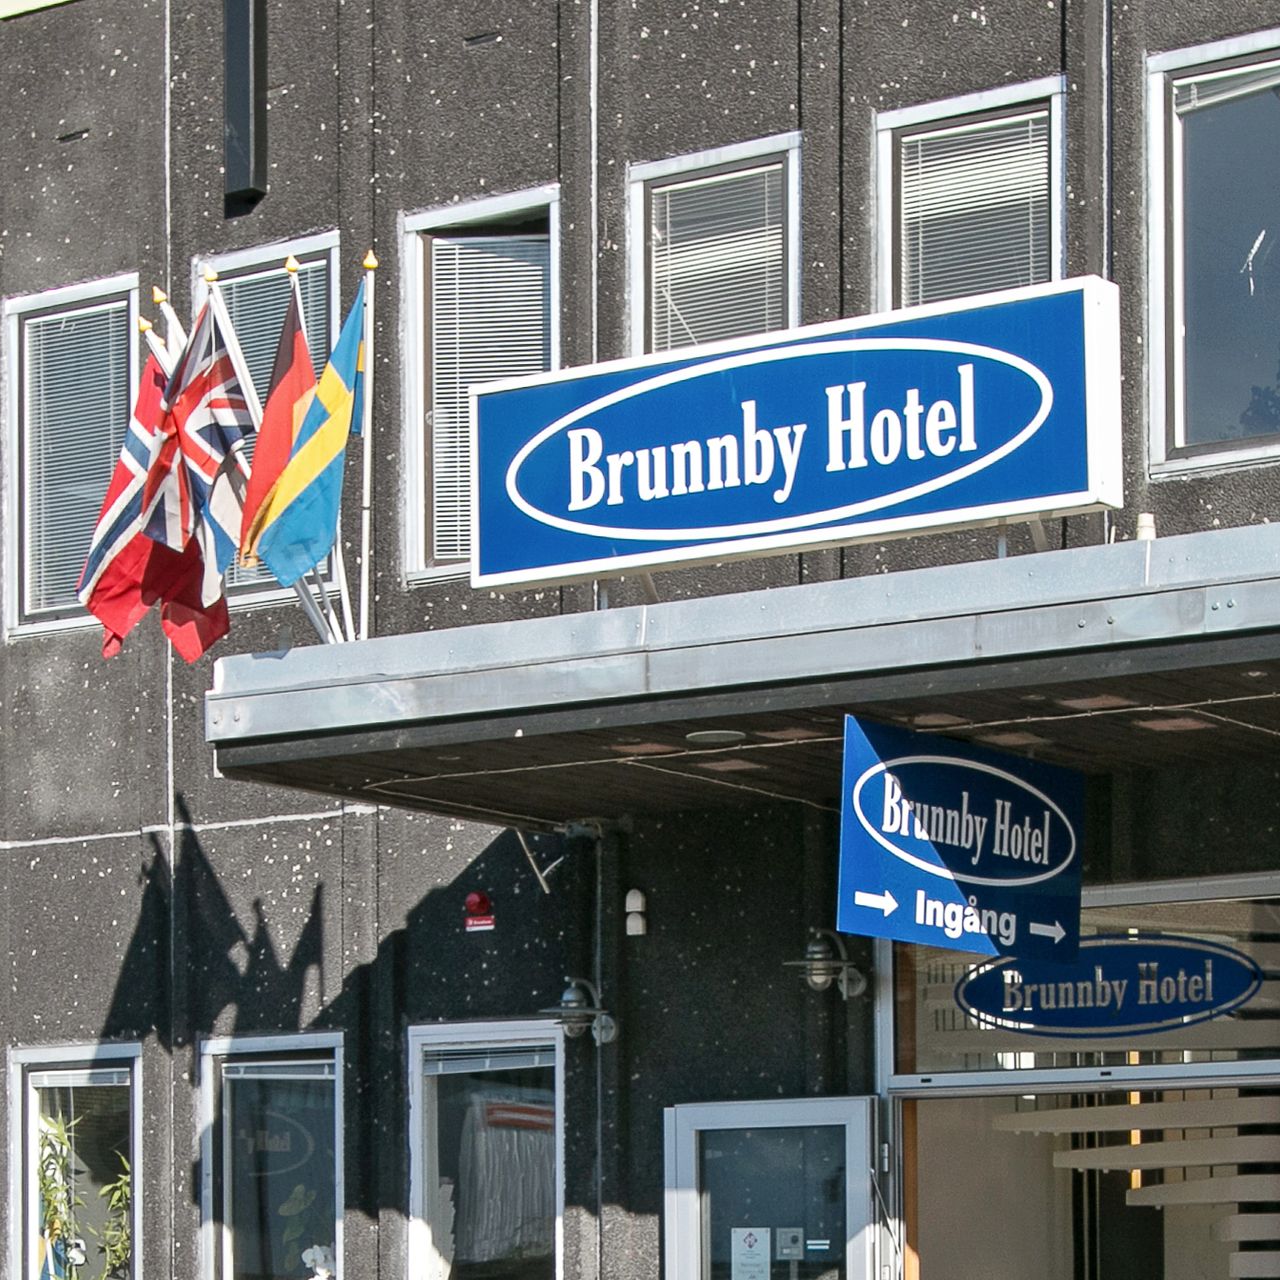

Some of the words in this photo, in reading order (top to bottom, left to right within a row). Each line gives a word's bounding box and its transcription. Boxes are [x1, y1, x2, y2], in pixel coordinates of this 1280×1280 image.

[567, 399, 808, 512] Brunnby
[825, 363, 978, 473] Hotel
[881, 772, 988, 866] Brunnby
[992, 799, 1051, 865] Hotel
[915, 889, 1017, 947] Ingång
[1002, 964, 1129, 1013] Brunnby
[1137, 959, 1214, 1005] Hotel
